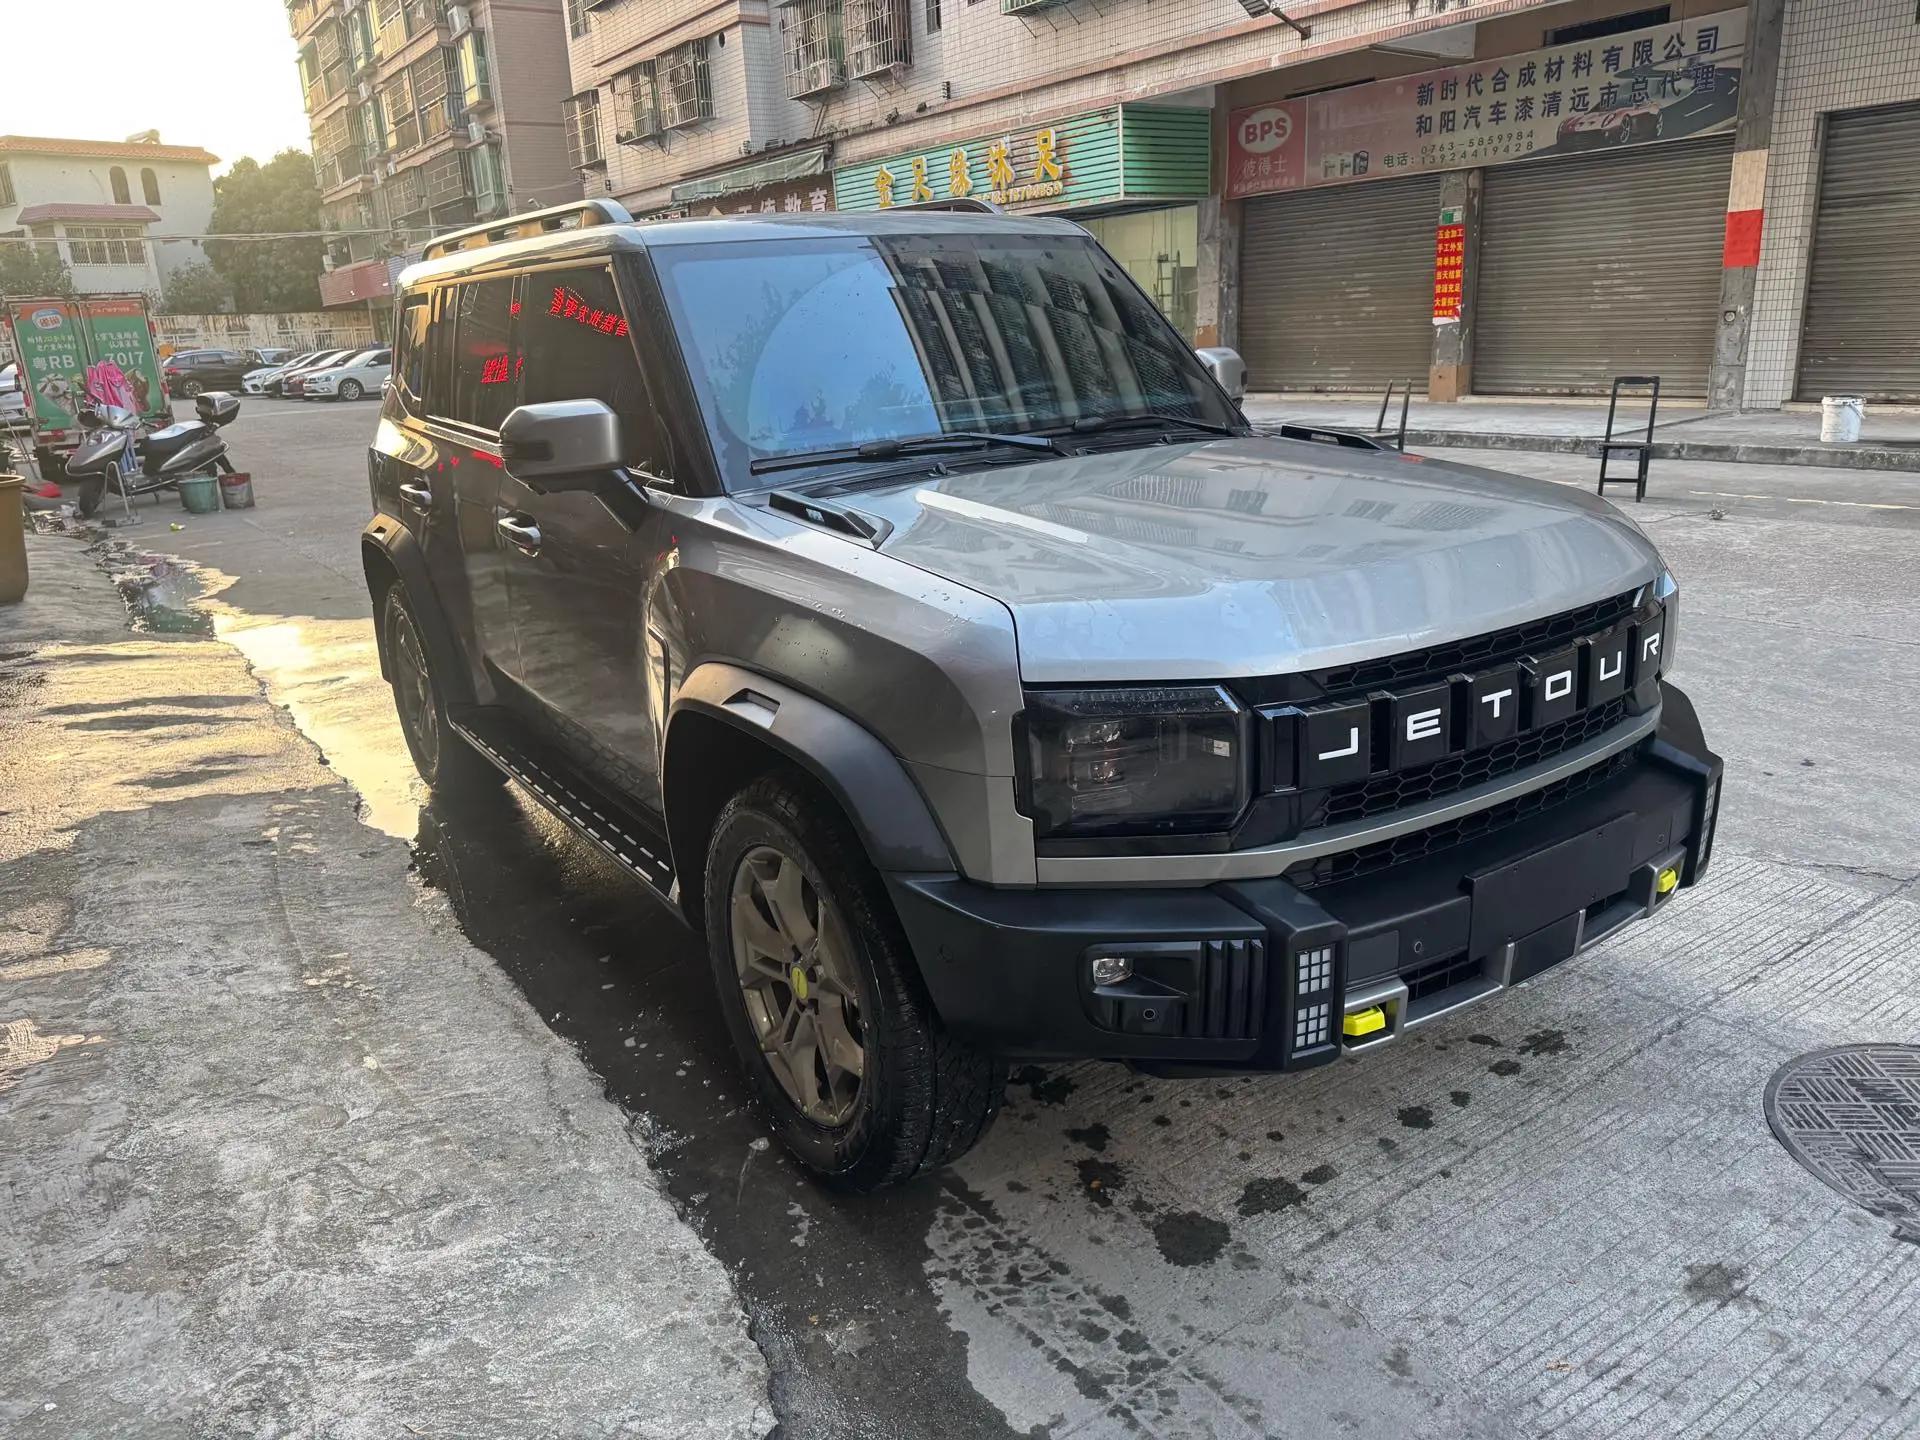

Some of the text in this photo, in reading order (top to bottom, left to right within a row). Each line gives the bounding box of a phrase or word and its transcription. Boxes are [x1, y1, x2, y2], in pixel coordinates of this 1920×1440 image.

[1416, 26, 1720, 107] 新时代合成材料有限公司
[1415, 63, 1716, 138] 和阳汽车漆清远市总代理
[1244, 117, 1288, 145] BPS
[1421, 130, 1534, 155] 0763-5859984
[1421, 141, 1534, 165] 13924419428
[1243, 155, 1288, 177] 彼得士
[1437, 228, 1464, 239] 五金加工
[1437, 241, 1463, 253] 手工外发
[1318, 631, 1661, 762] JETOUR
